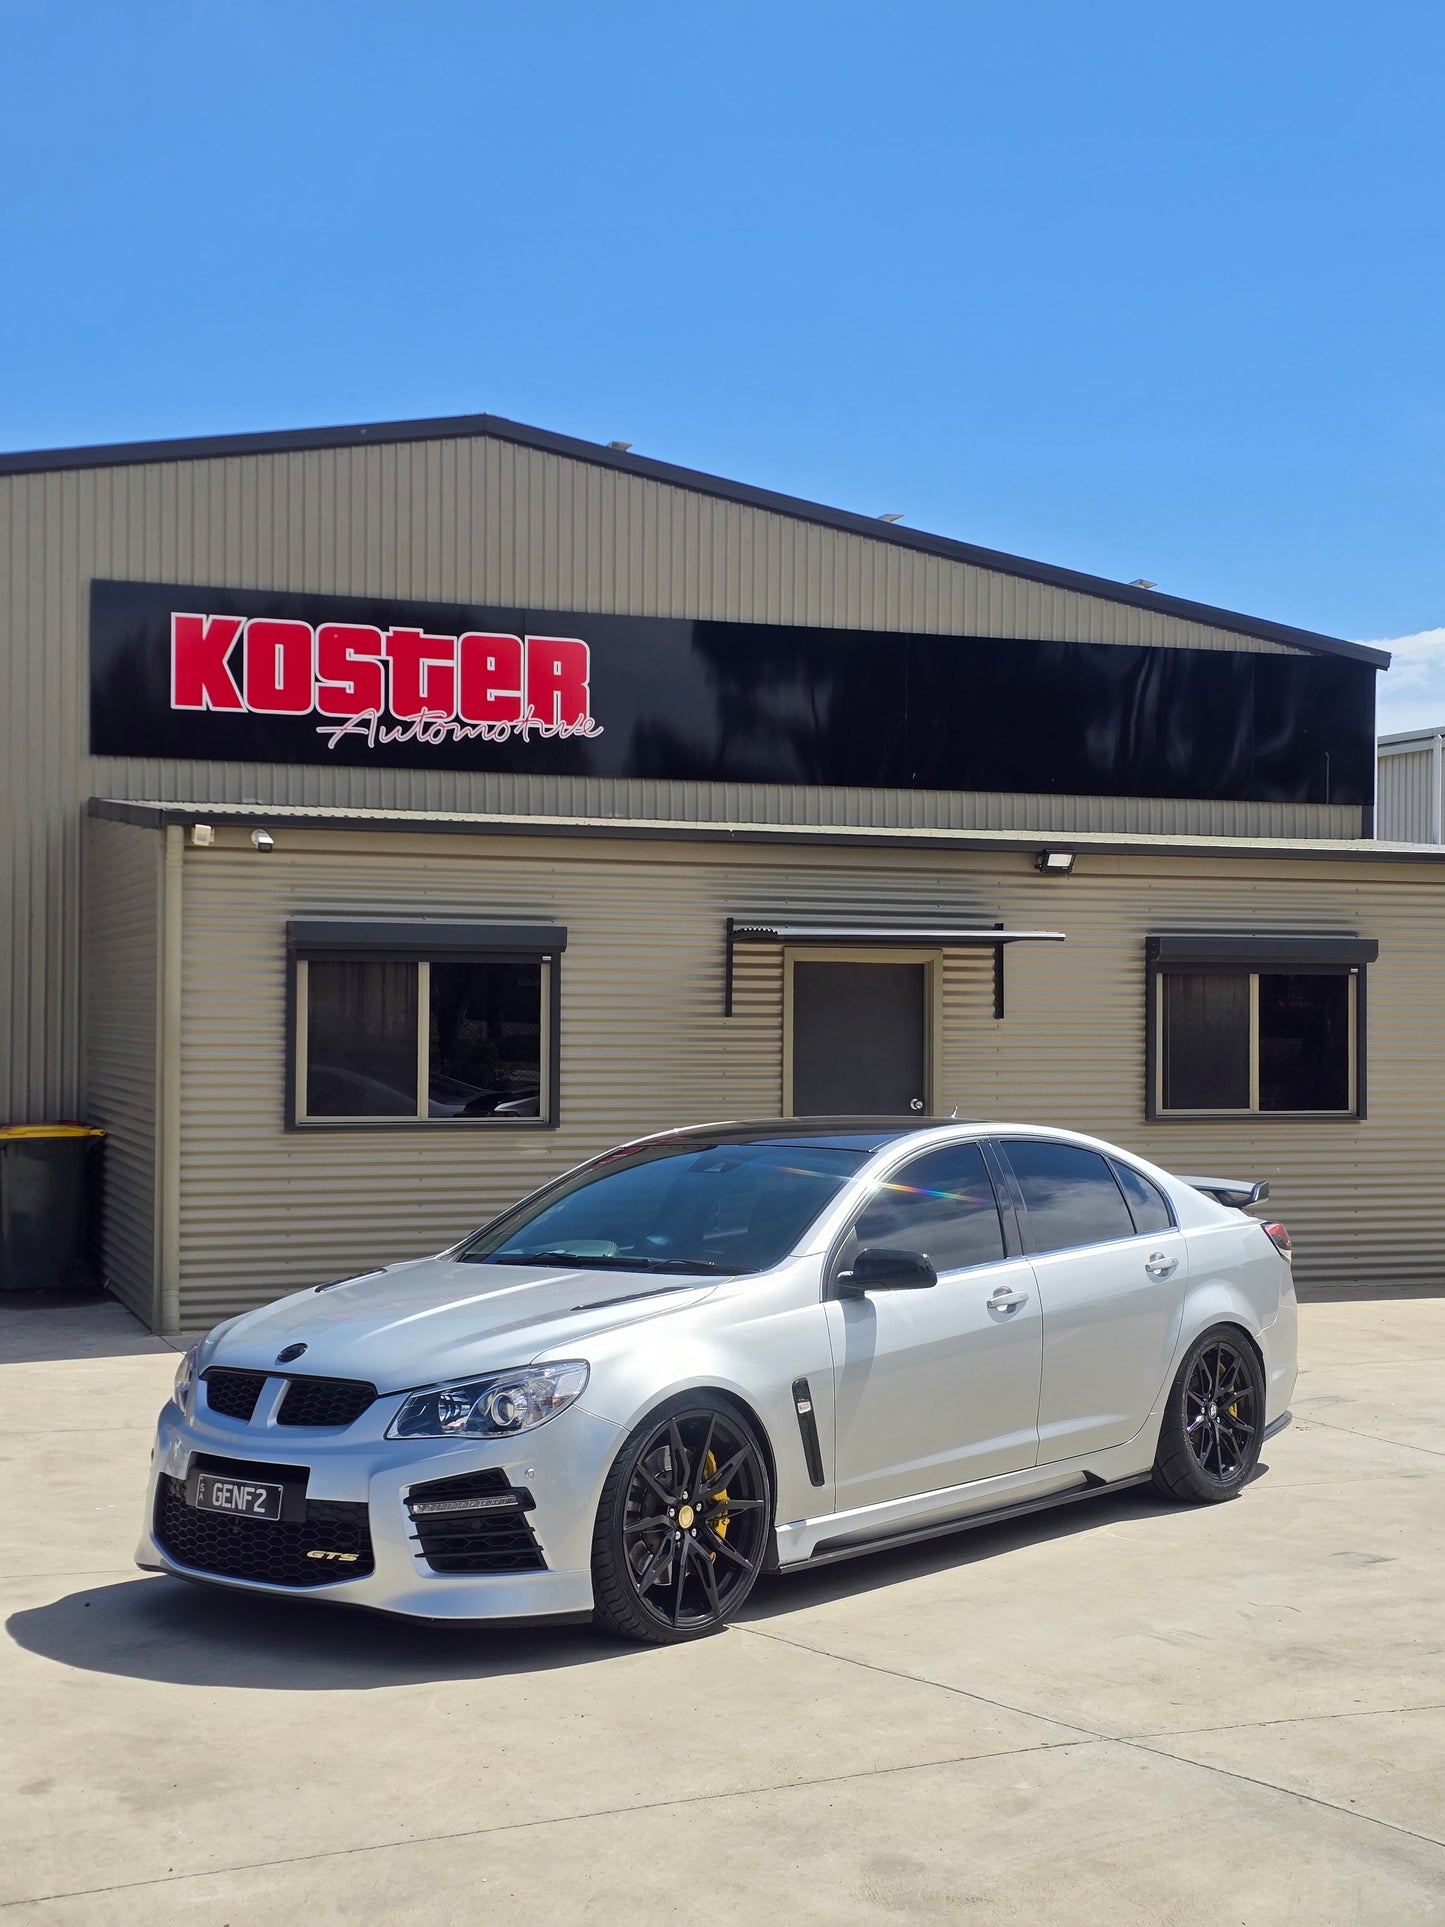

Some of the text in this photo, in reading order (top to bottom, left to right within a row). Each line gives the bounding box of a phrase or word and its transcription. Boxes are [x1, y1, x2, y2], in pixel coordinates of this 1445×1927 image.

[316, 705, 605, 750] Automotive
[212, 1482, 267, 1513] GENF2
[307, 1550, 360, 1562] GTS
